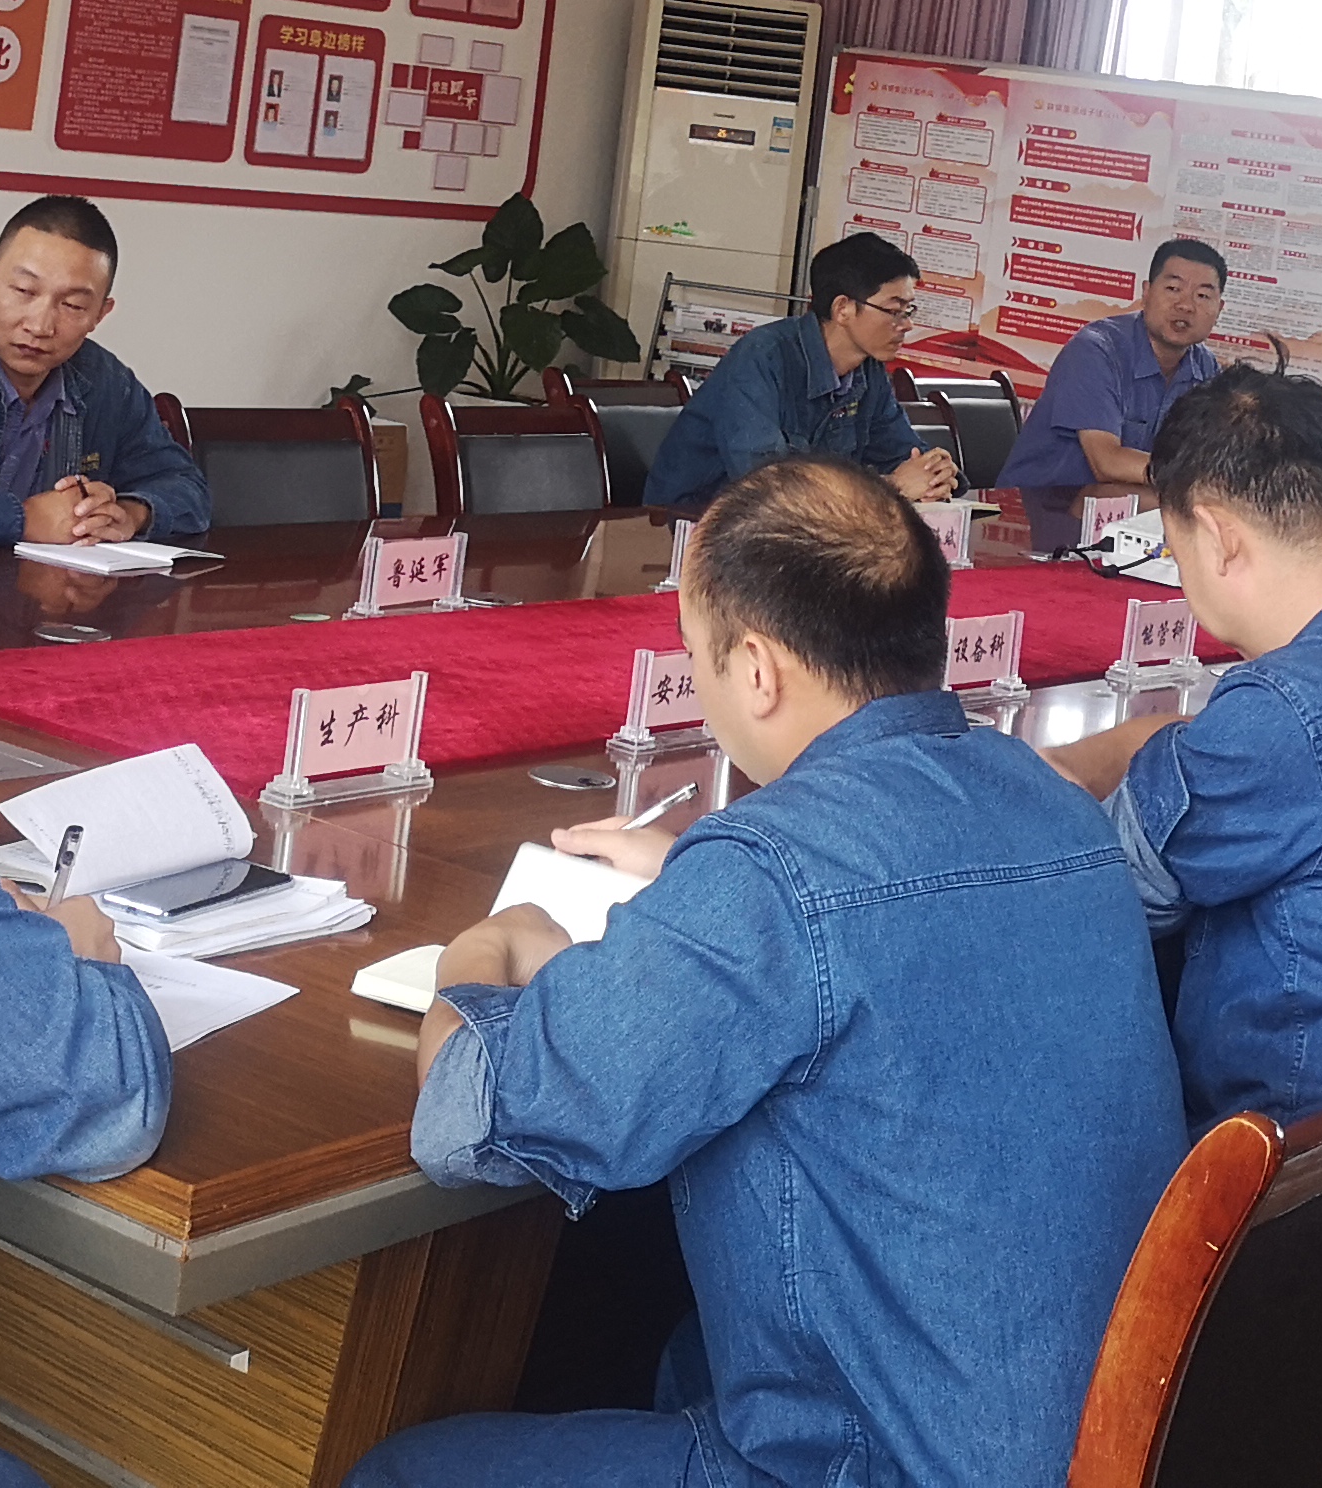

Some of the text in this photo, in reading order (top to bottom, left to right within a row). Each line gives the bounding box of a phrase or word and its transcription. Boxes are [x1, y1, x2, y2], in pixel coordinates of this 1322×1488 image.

[279, 25, 366, 52] 学习身边榜样
[388, 553, 449, 589] 鲁延军
[954, 632, 1005, 662] 设备科
[651, 674, 695, 705] 安环
[320, 699, 400, 747] 生产科
